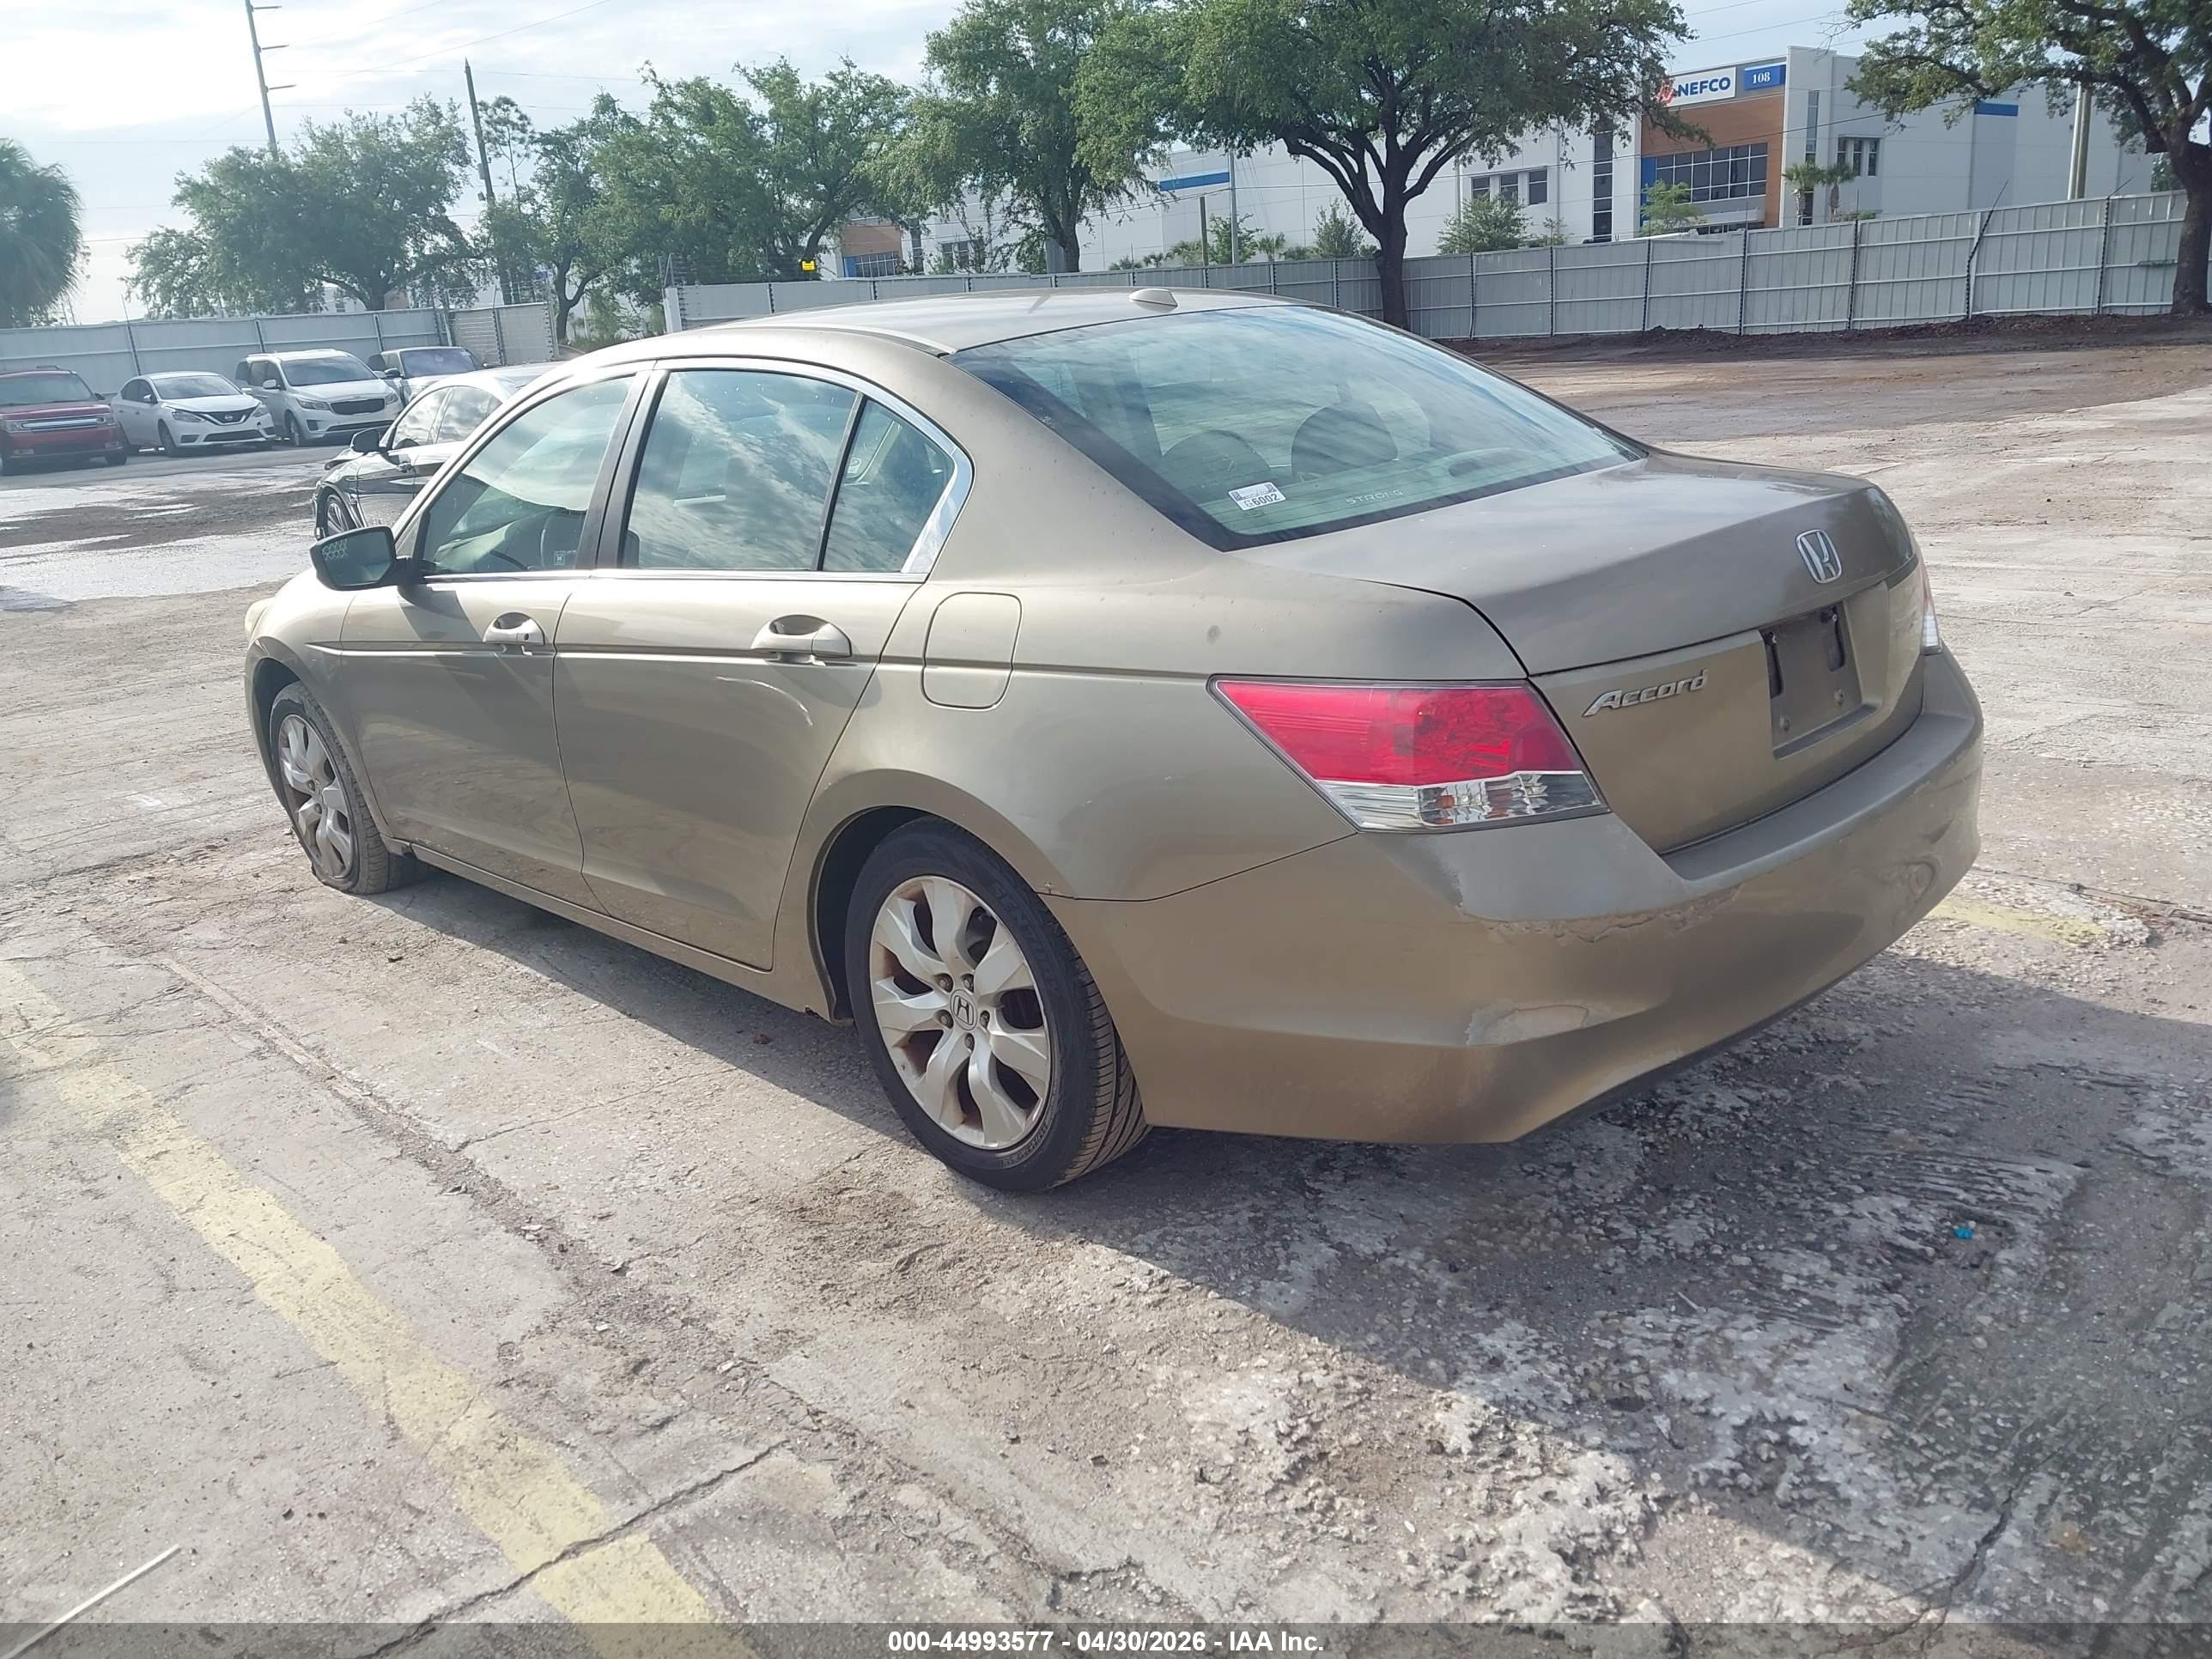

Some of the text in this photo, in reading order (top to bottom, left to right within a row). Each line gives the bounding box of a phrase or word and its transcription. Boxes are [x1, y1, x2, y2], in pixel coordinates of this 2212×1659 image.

[1678, 76, 1731, 97] NEFCO
[1753, 72, 1771, 84] 108
[1582, 670, 1710, 717] Accord
